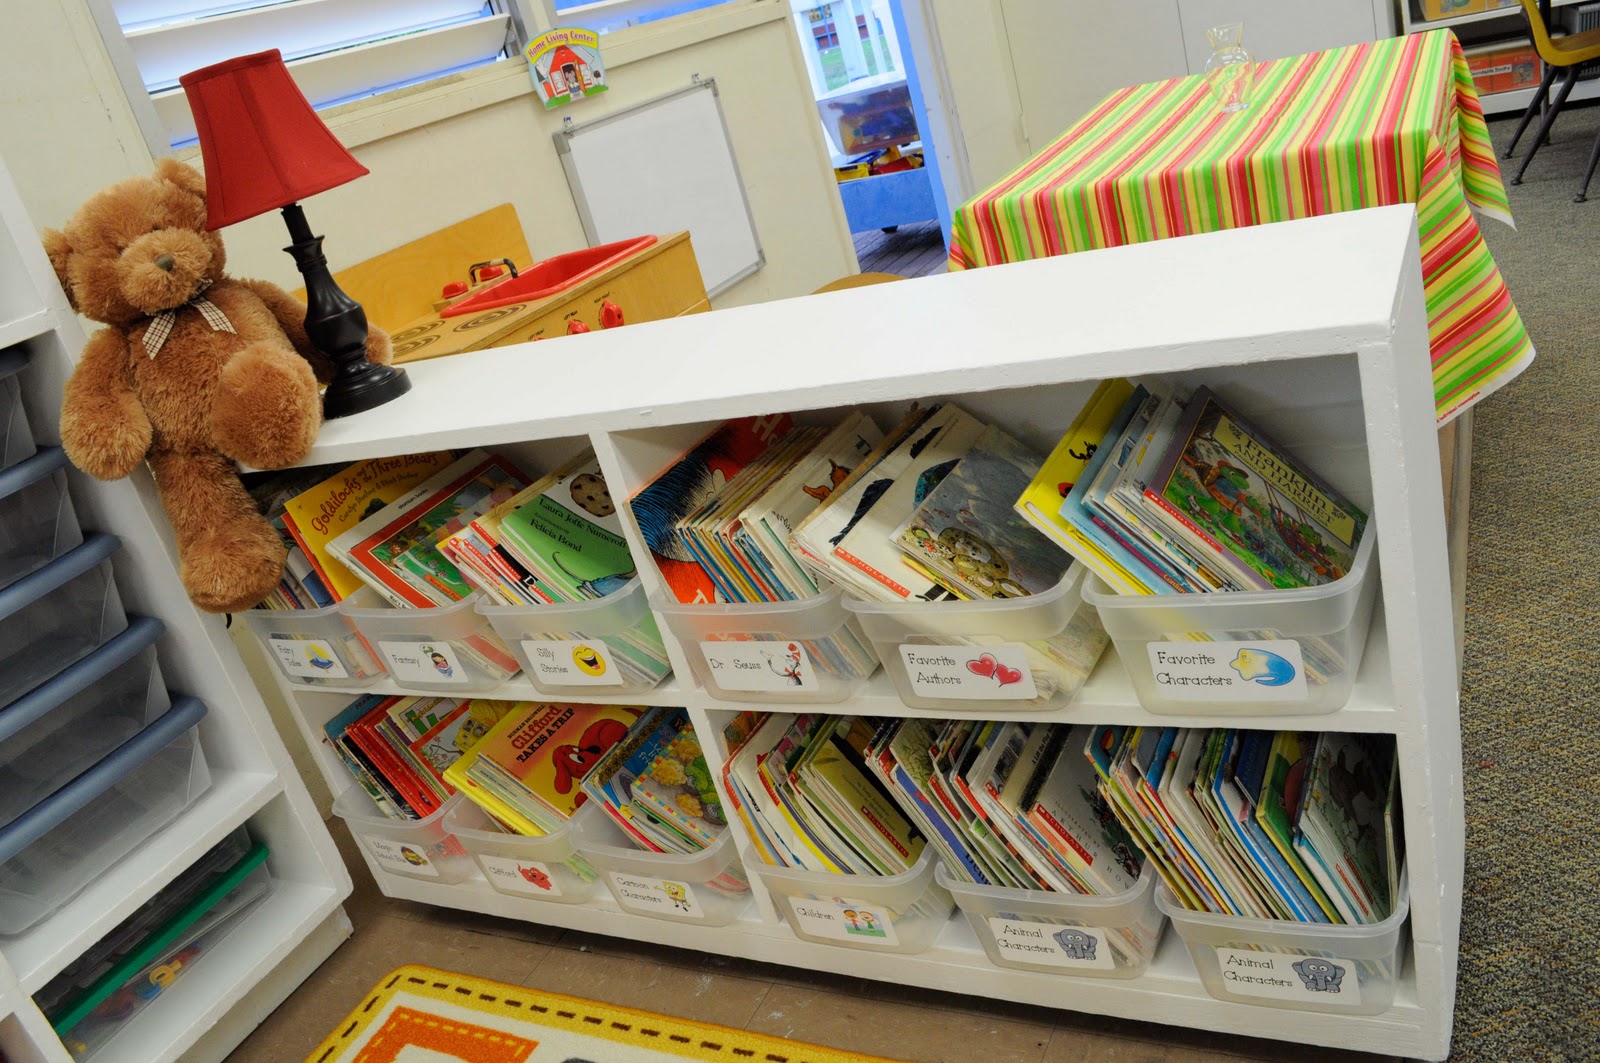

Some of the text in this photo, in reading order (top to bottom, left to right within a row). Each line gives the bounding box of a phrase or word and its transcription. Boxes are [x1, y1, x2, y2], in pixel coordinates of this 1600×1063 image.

[528, 30, 594, 58] Home Living Center
[367, 452, 438, 478] Three Bears
[1246, 437, 1326, 508] Franklin
[1234, 443, 1335, 524] AND HARRIET
[415, 488, 429, 498] books
[311, 474, 362, 536] Goldilocks
[539, 498, 626, 549] Laura Joffe Numeroff
[1156, 499, 1219, 547] SCHOLASTIC
[530, 518, 582, 552] Felicia Bond
[846, 553, 909, 596] SCHOLASTIC
[277, 644, 296, 657] Fairy
[536, 648, 554, 662] Silly
[1157, 652, 1216, 665] Favorite
[285, 658, 302, 668] Tales
[392, 654, 420, 668] Fantasy
[710, 658, 762, 670] Dr. Seuss
[908, 652, 956, 666] Favorite
[540, 663, 568, 674] Stories
[916, 672, 962, 685] Authors
[1156, 672, 1232, 686] Characters
[511, 704, 562, 750] Clifford
[516, 733, 549, 763] TAKES
[552, 708, 575, 730] TRIP
[868, 813, 908, 857] SCHOLASTIC
[1046, 812, 1092, 862] SCHOLASTIC
[1052, 810, 1098, 857] ARTHUR
[488, 866, 518, 879] Clifford
[616, 877, 650, 890] Cartoon
[620, 888, 662, 904] Characters
[797, 907, 835, 921] Children
[1004, 924, 1044, 940] Animal
[997, 938, 1056, 955] Characters
[1227, 954, 1274, 970] Animal
[1224, 970, 1294, 988] Characters
